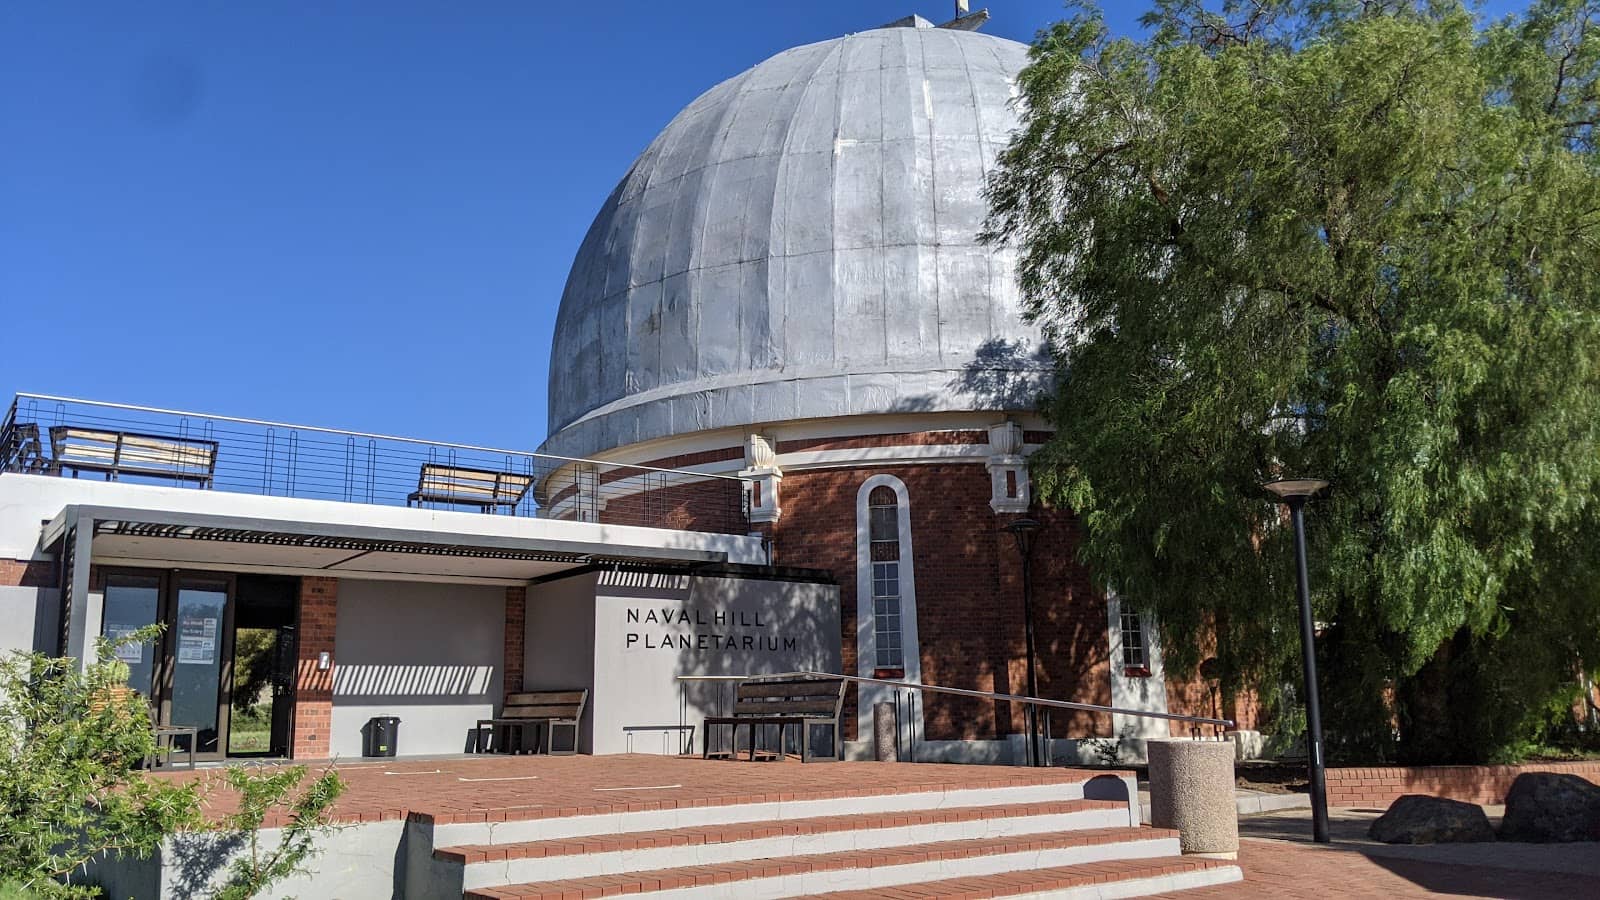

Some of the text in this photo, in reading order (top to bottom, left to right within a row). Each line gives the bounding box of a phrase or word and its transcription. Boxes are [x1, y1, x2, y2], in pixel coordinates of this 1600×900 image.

[627, 608, 765, 627] NAVAL HILL
[626, 633, 796, 652] PLANETARIUM
